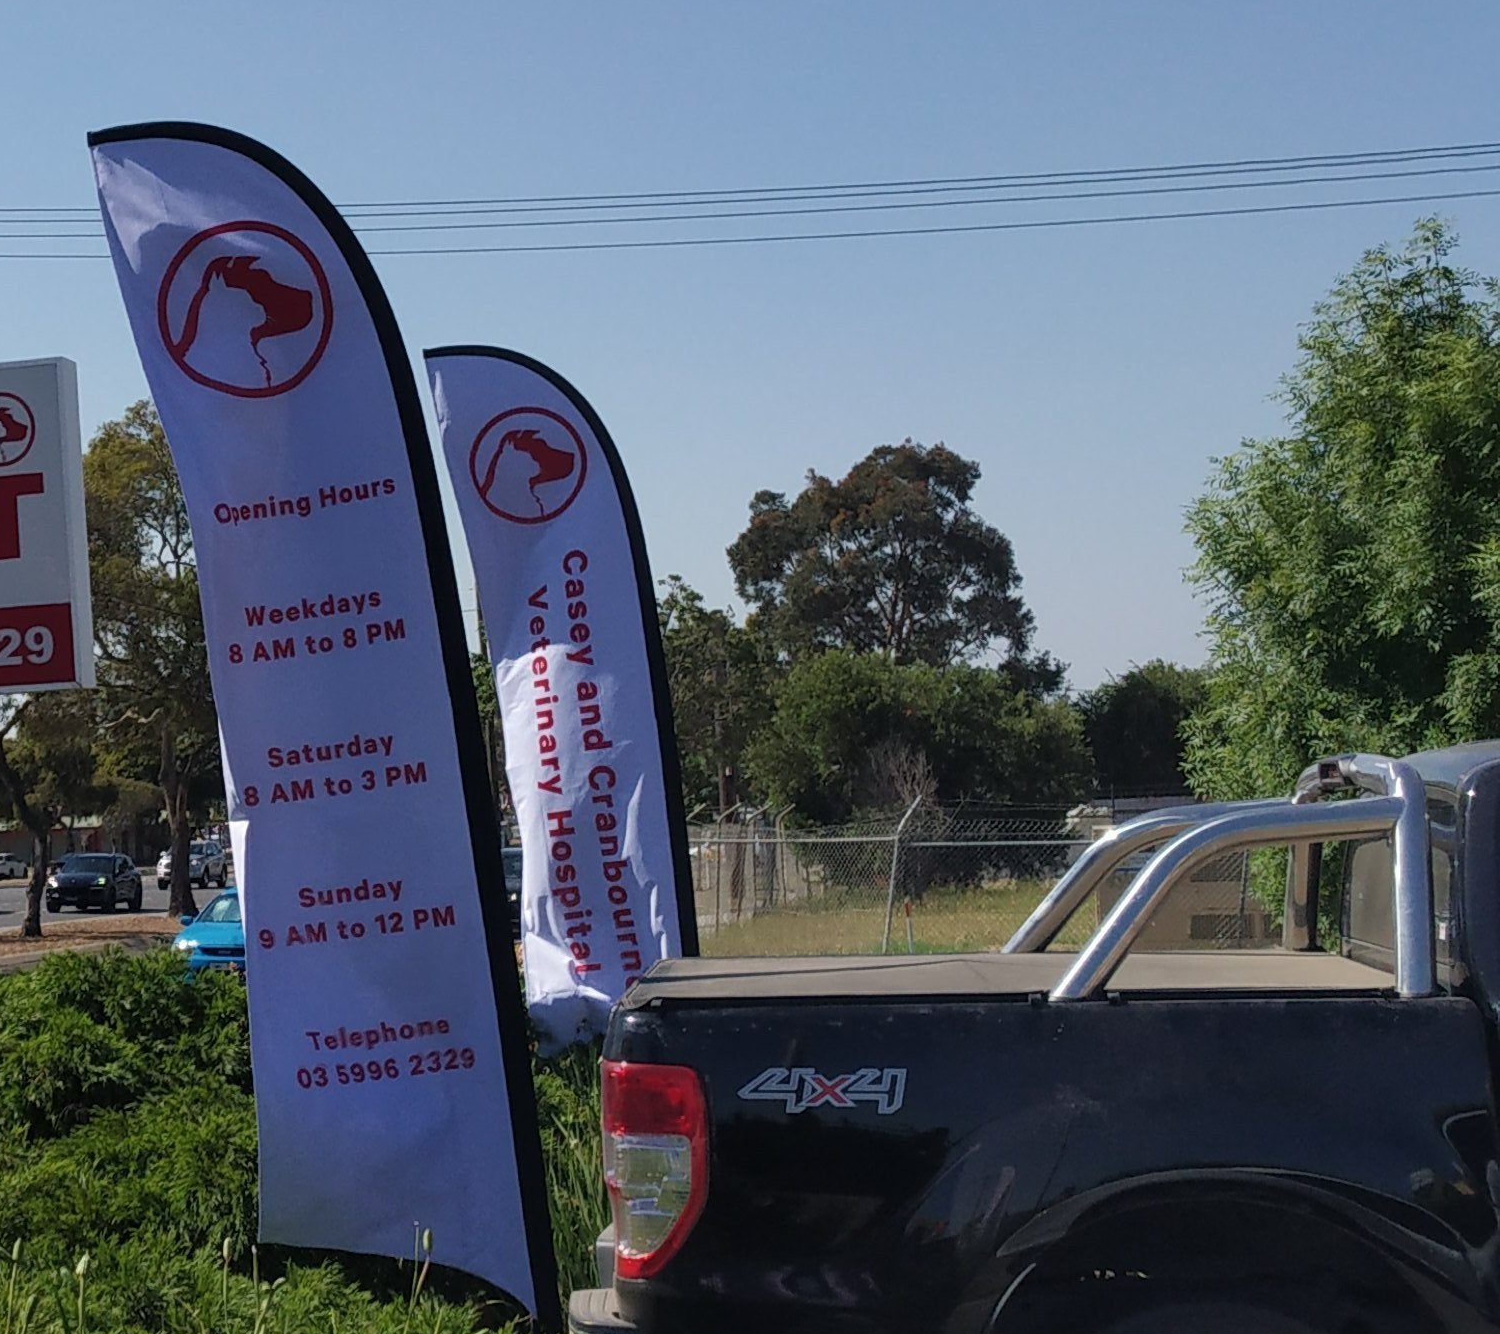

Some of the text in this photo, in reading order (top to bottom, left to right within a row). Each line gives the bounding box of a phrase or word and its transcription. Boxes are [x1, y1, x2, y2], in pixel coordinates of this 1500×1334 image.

[213, 477, 396, 527] Opening Hours
[244, 591, 382, 628] Weekdays
[562, 549, 594, 666] Casey
[228, 618, 406, 664] 8 AM to 8 PM
[576, 680, 613, 752] and
[267, 734, 394, 768] Saturday
[243, 761, 428, 807] 8 AM to 3 PM
[527, 584, 602, 973] Veterinary Hospital
[298, 878, 403, 908] Sunday
[258, 905, 456, 950] 9 AM to 12 PM
[305, 1018, 450, 1051] Telephone
[297, 1047, 476, 1090] 03 5996 2329
